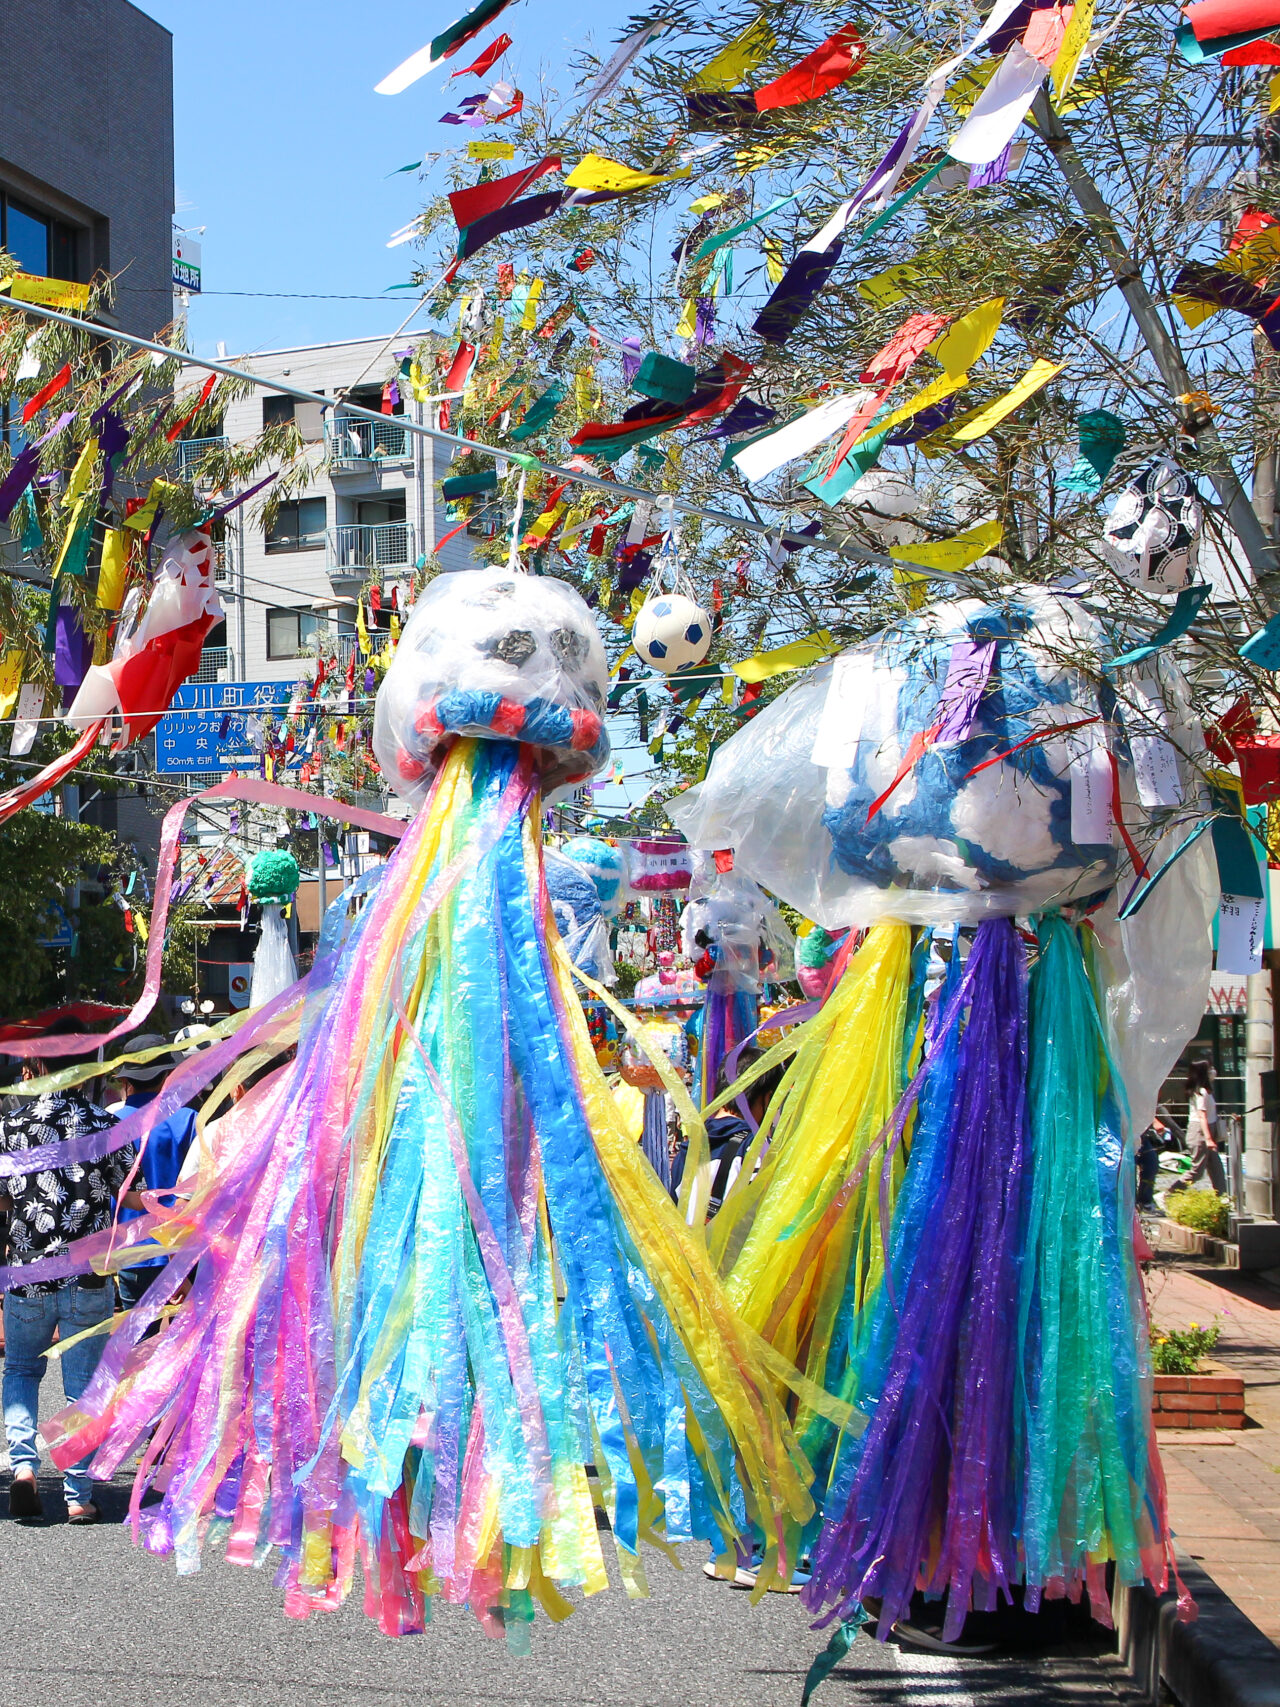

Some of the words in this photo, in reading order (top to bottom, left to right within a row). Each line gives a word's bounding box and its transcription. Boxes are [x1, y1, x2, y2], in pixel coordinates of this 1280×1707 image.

[164, 721, 244, 735] リリックおわ
[197, 755, 213, 765] 右折
